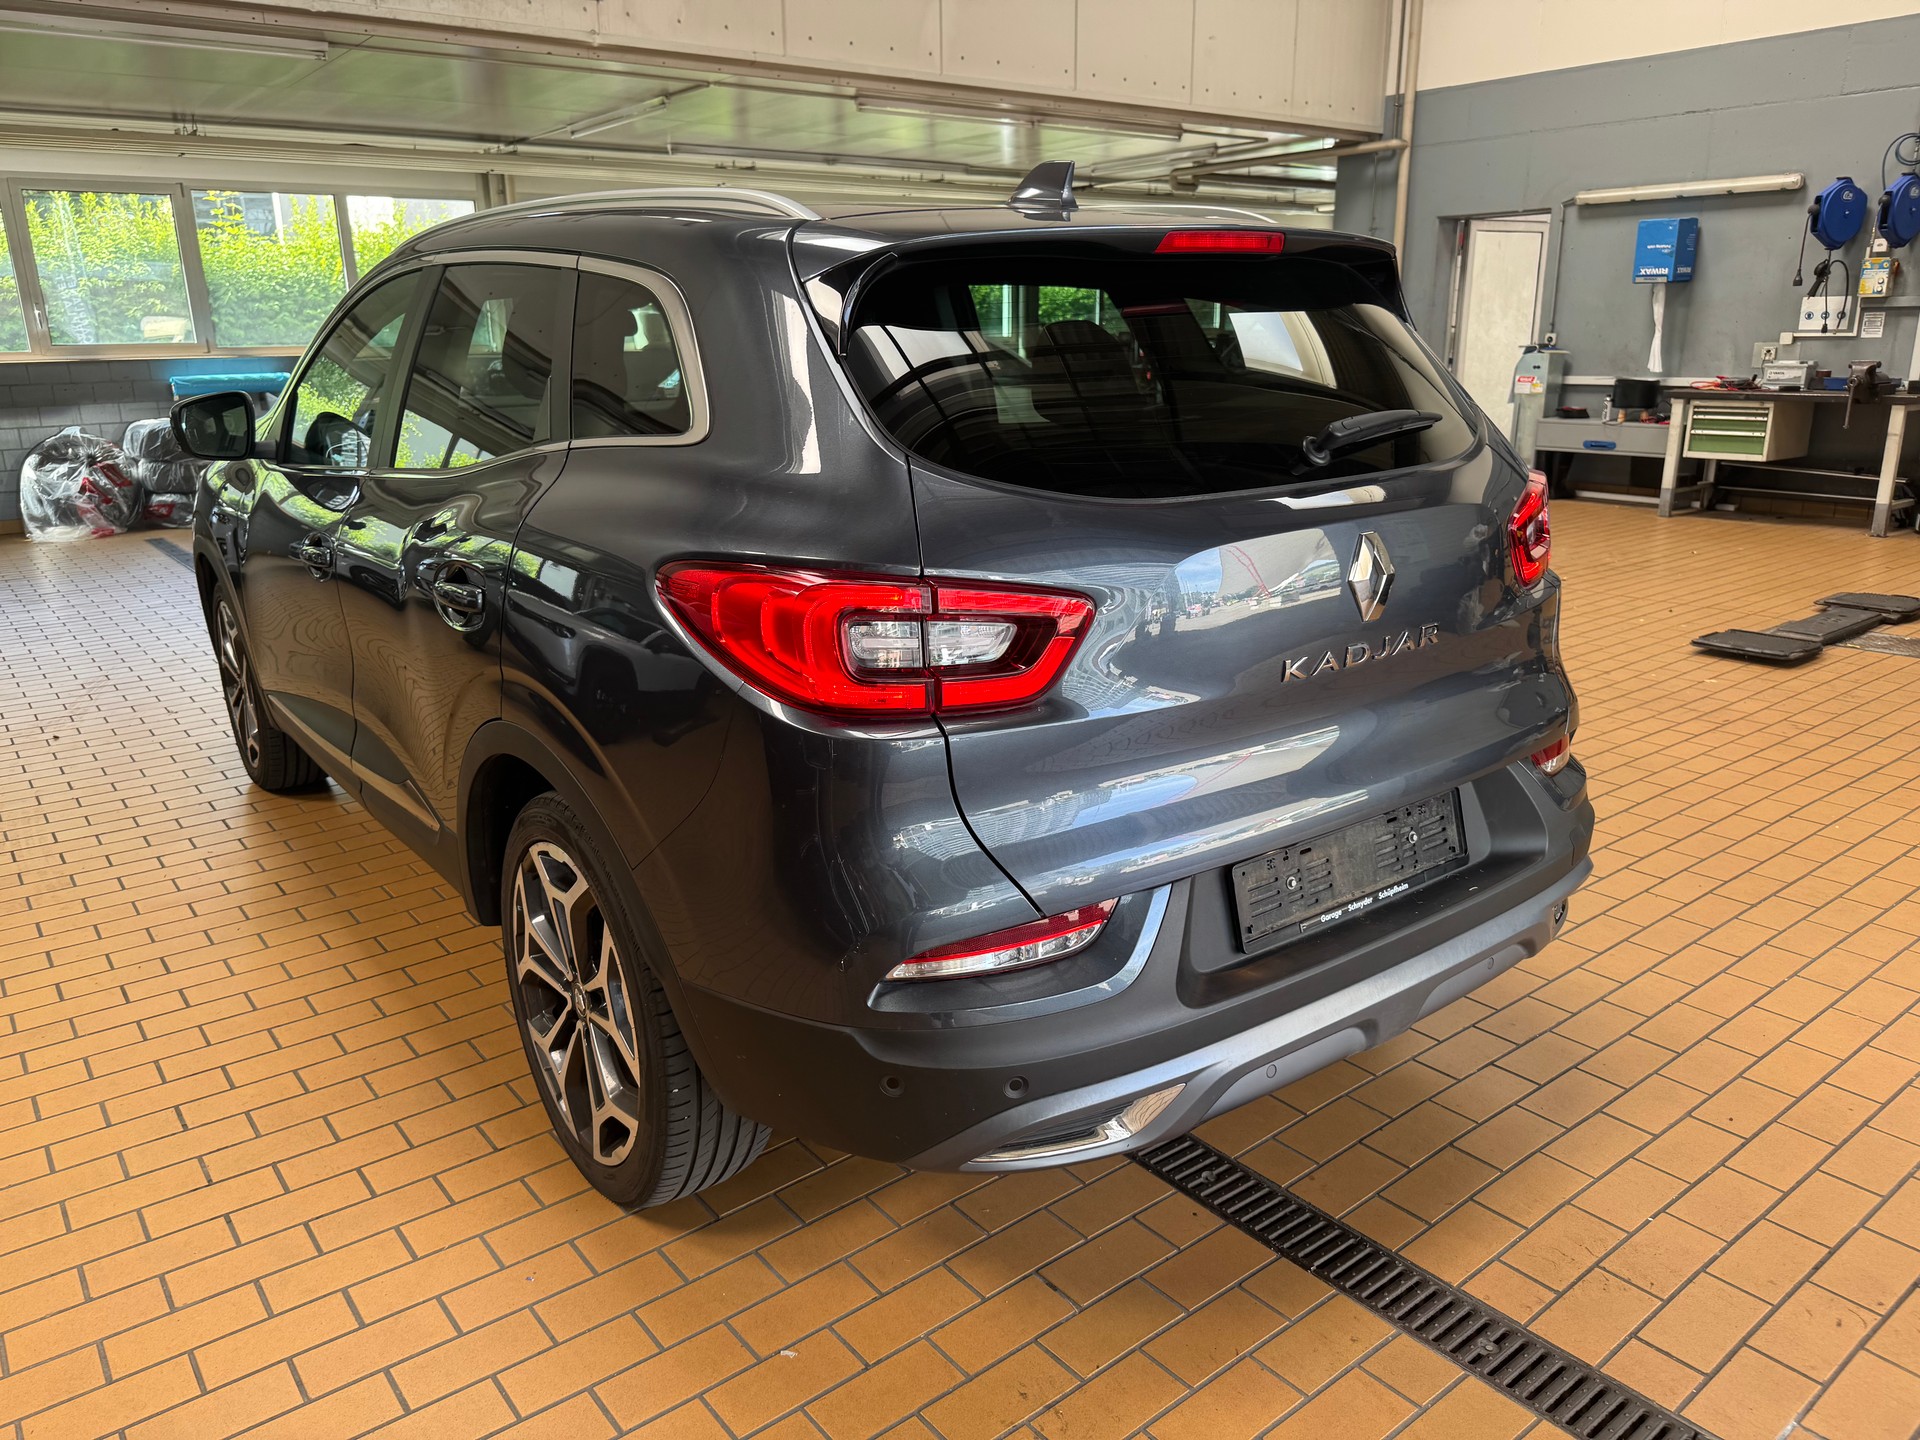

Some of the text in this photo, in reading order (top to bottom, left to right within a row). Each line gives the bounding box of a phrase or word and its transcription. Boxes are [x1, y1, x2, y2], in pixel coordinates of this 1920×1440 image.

[1640, 267, 1669, 275] RIWAX
[1281, 622, 1441, 683] KADJAR
[1320, 882, 1409, 923] Garage Schnyder Schüpfheim
